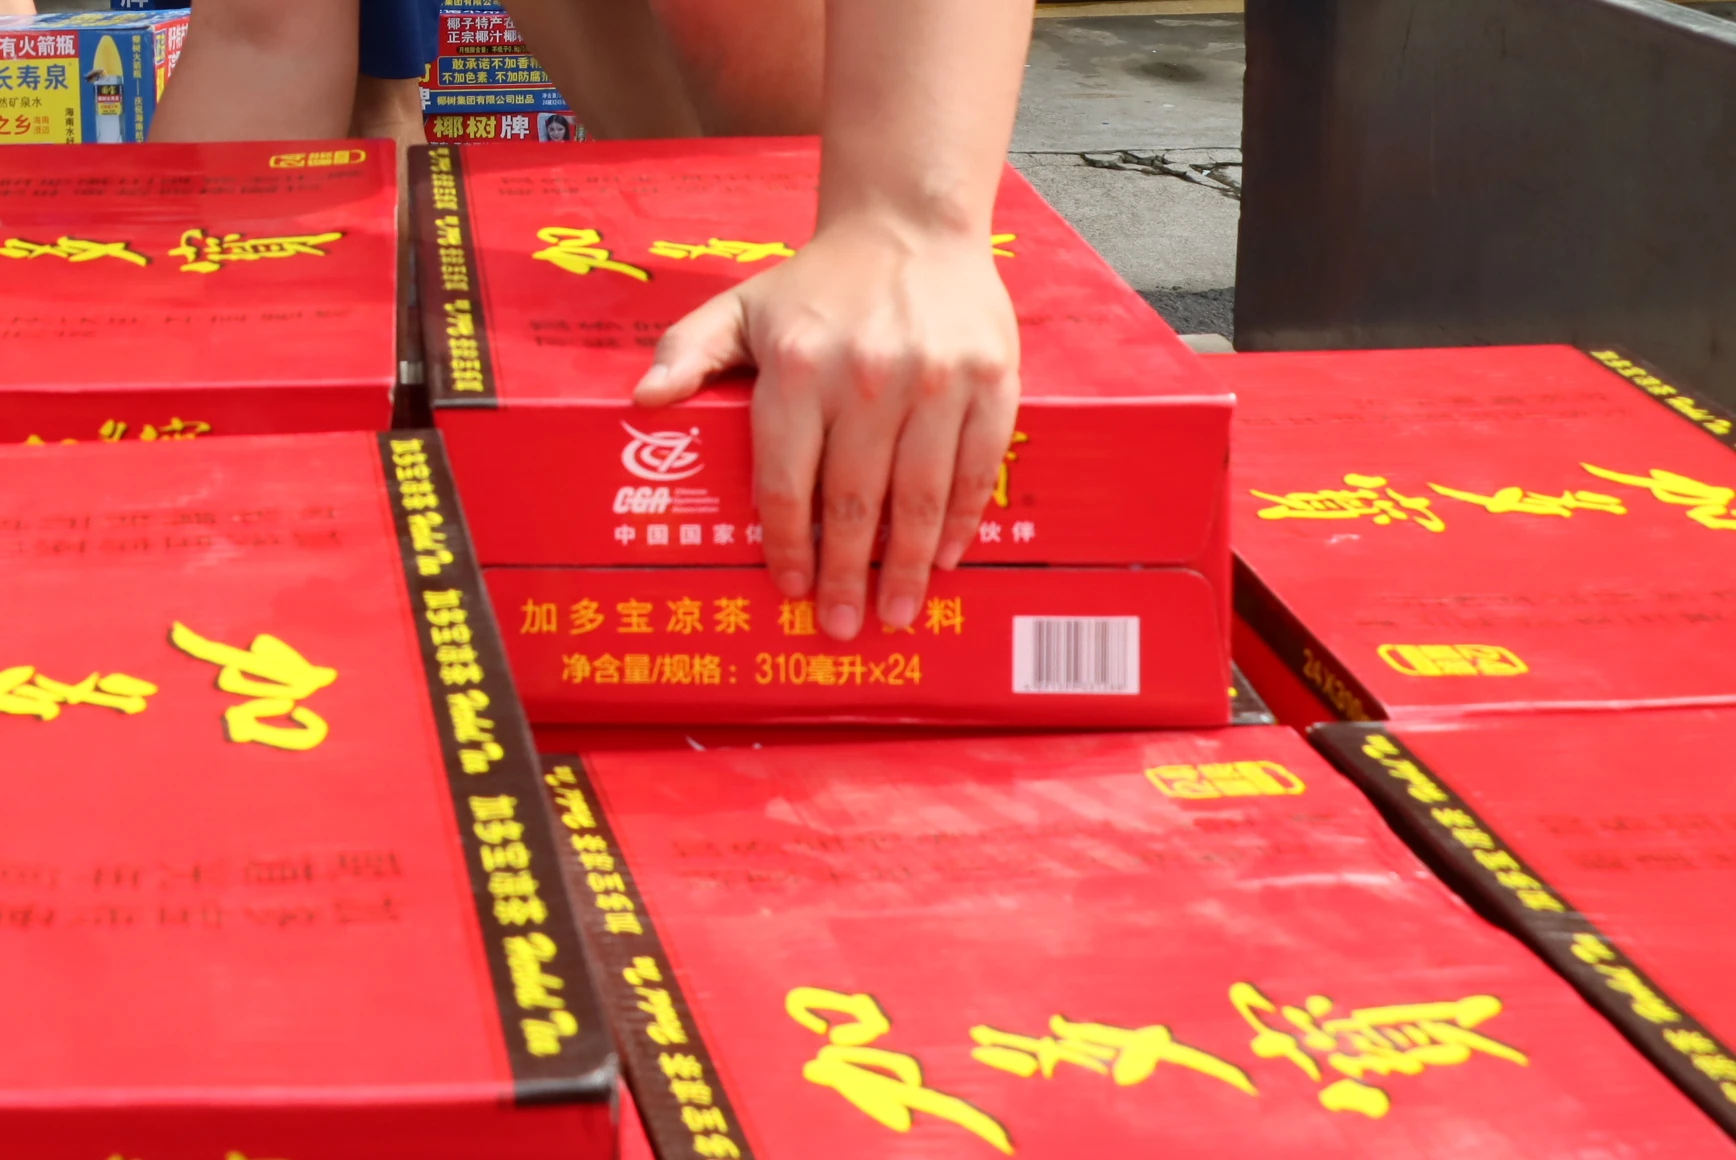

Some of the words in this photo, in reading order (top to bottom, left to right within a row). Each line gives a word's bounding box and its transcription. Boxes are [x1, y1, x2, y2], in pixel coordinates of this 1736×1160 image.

[437, 95, 535, 106] 椰树集团有限公司出品
[433, 115, 530, 139] 椰树牌
[612, 485, 672, 514] CGA
[520, 597, 752, 636] 加多宝凉茶
